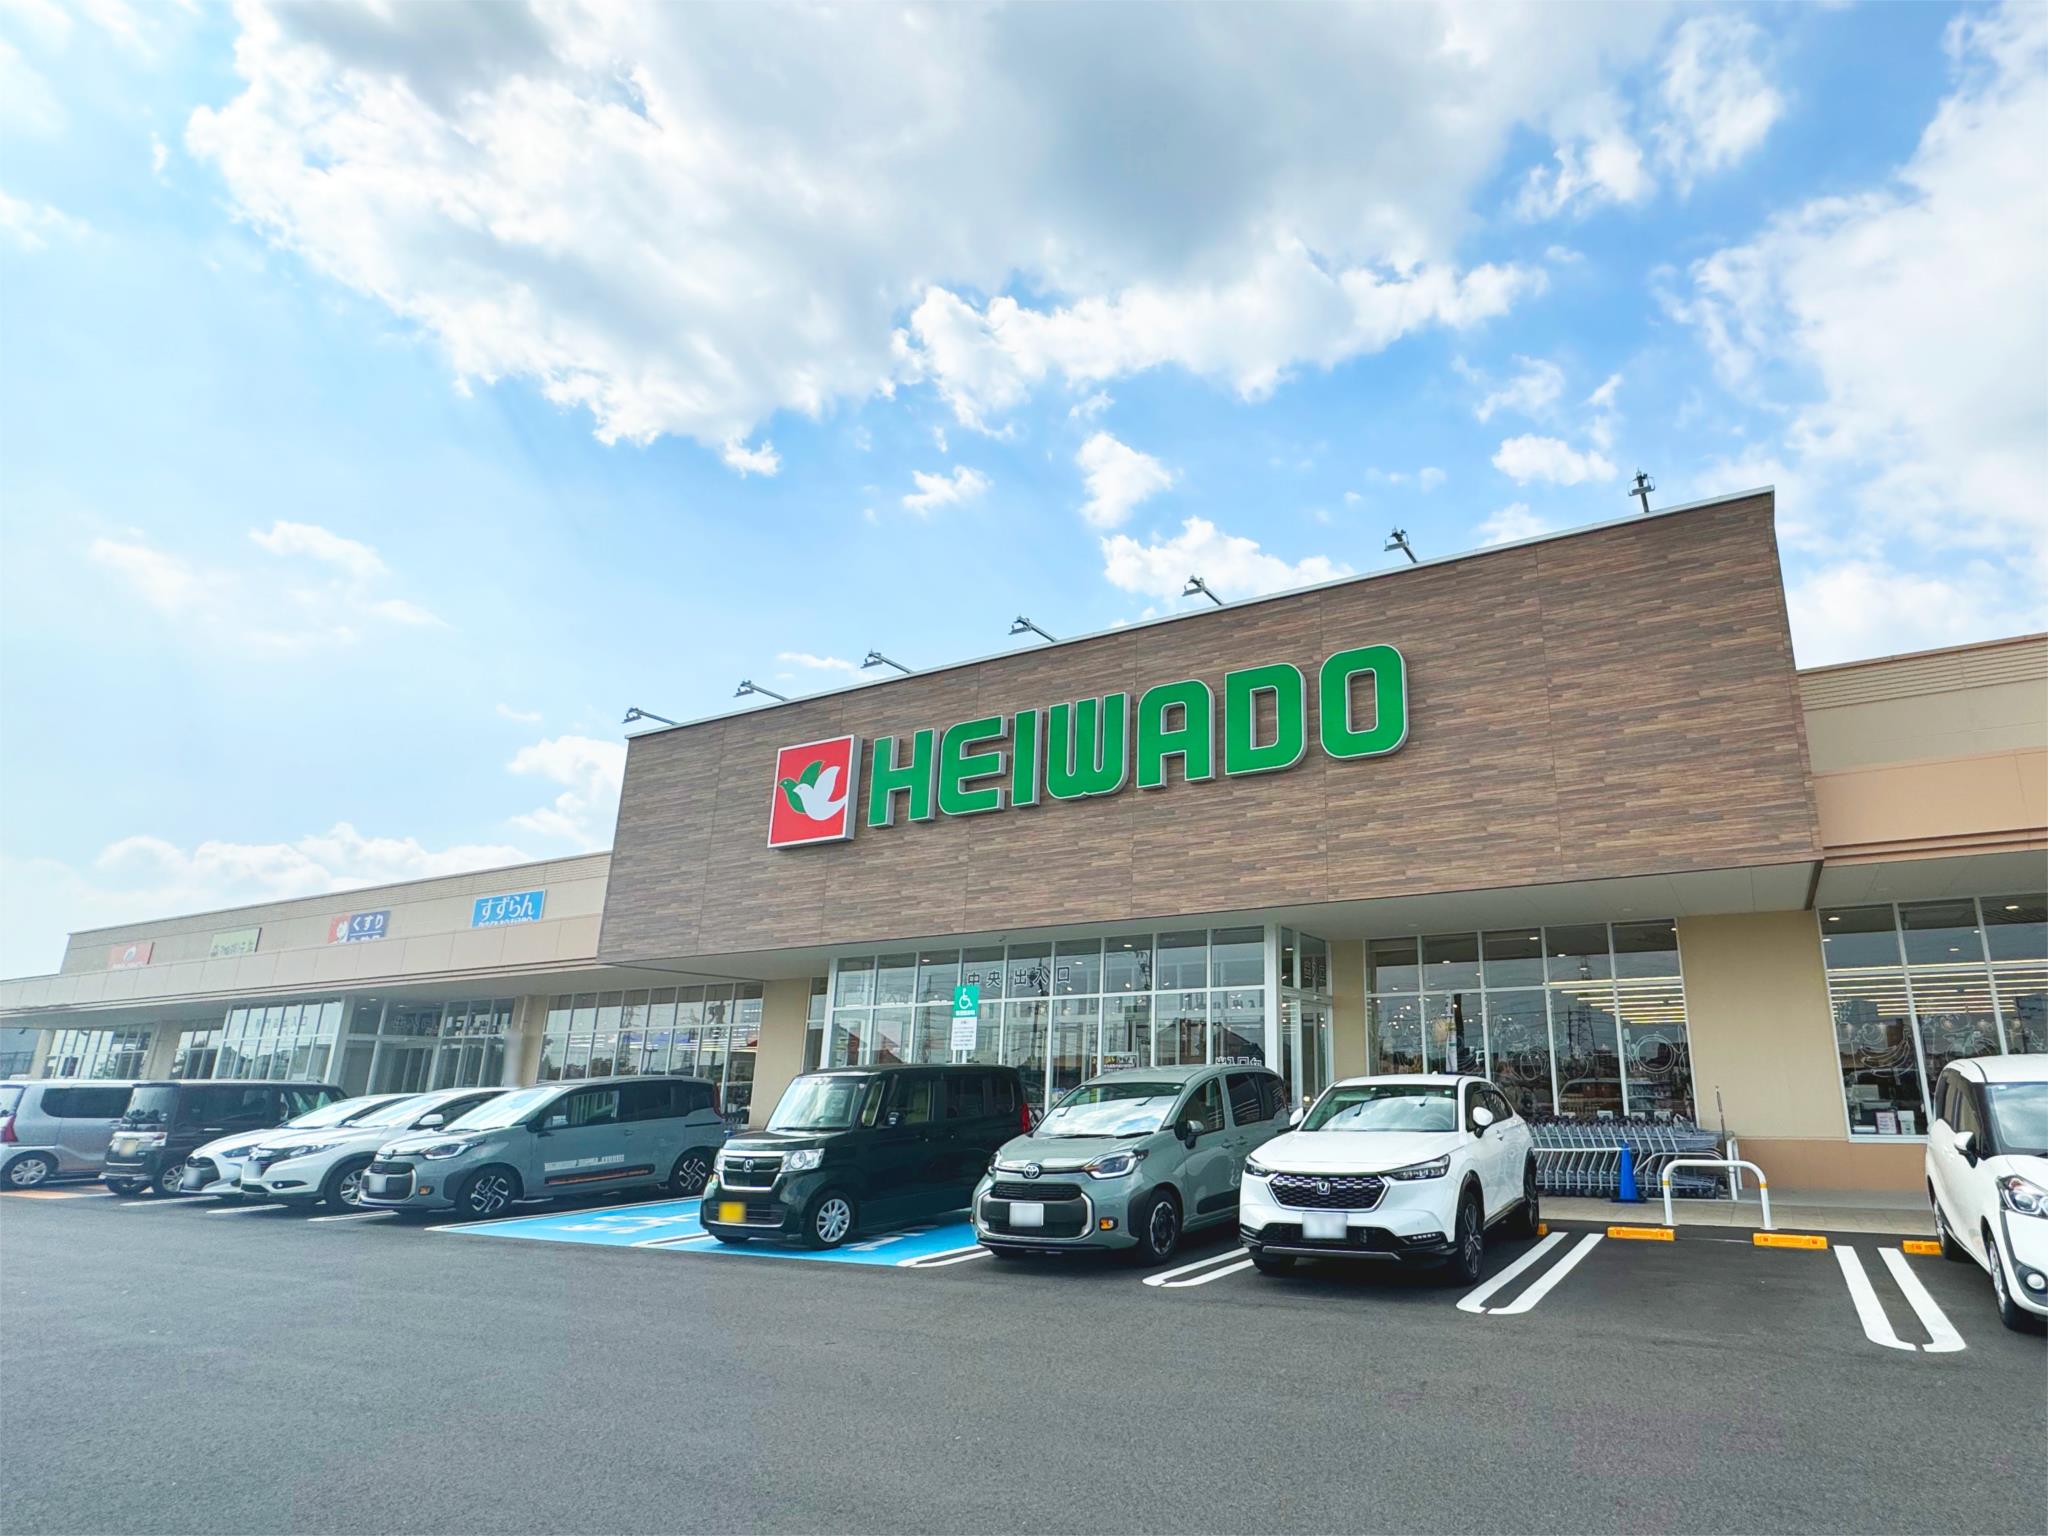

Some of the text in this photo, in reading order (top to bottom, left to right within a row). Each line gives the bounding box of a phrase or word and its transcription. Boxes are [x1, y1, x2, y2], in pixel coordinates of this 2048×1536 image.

[867, 643, 1408, 829] HEIWADO
[480, 894, 535, 921] すずらん
[352, 914, 384, 931] くすり
